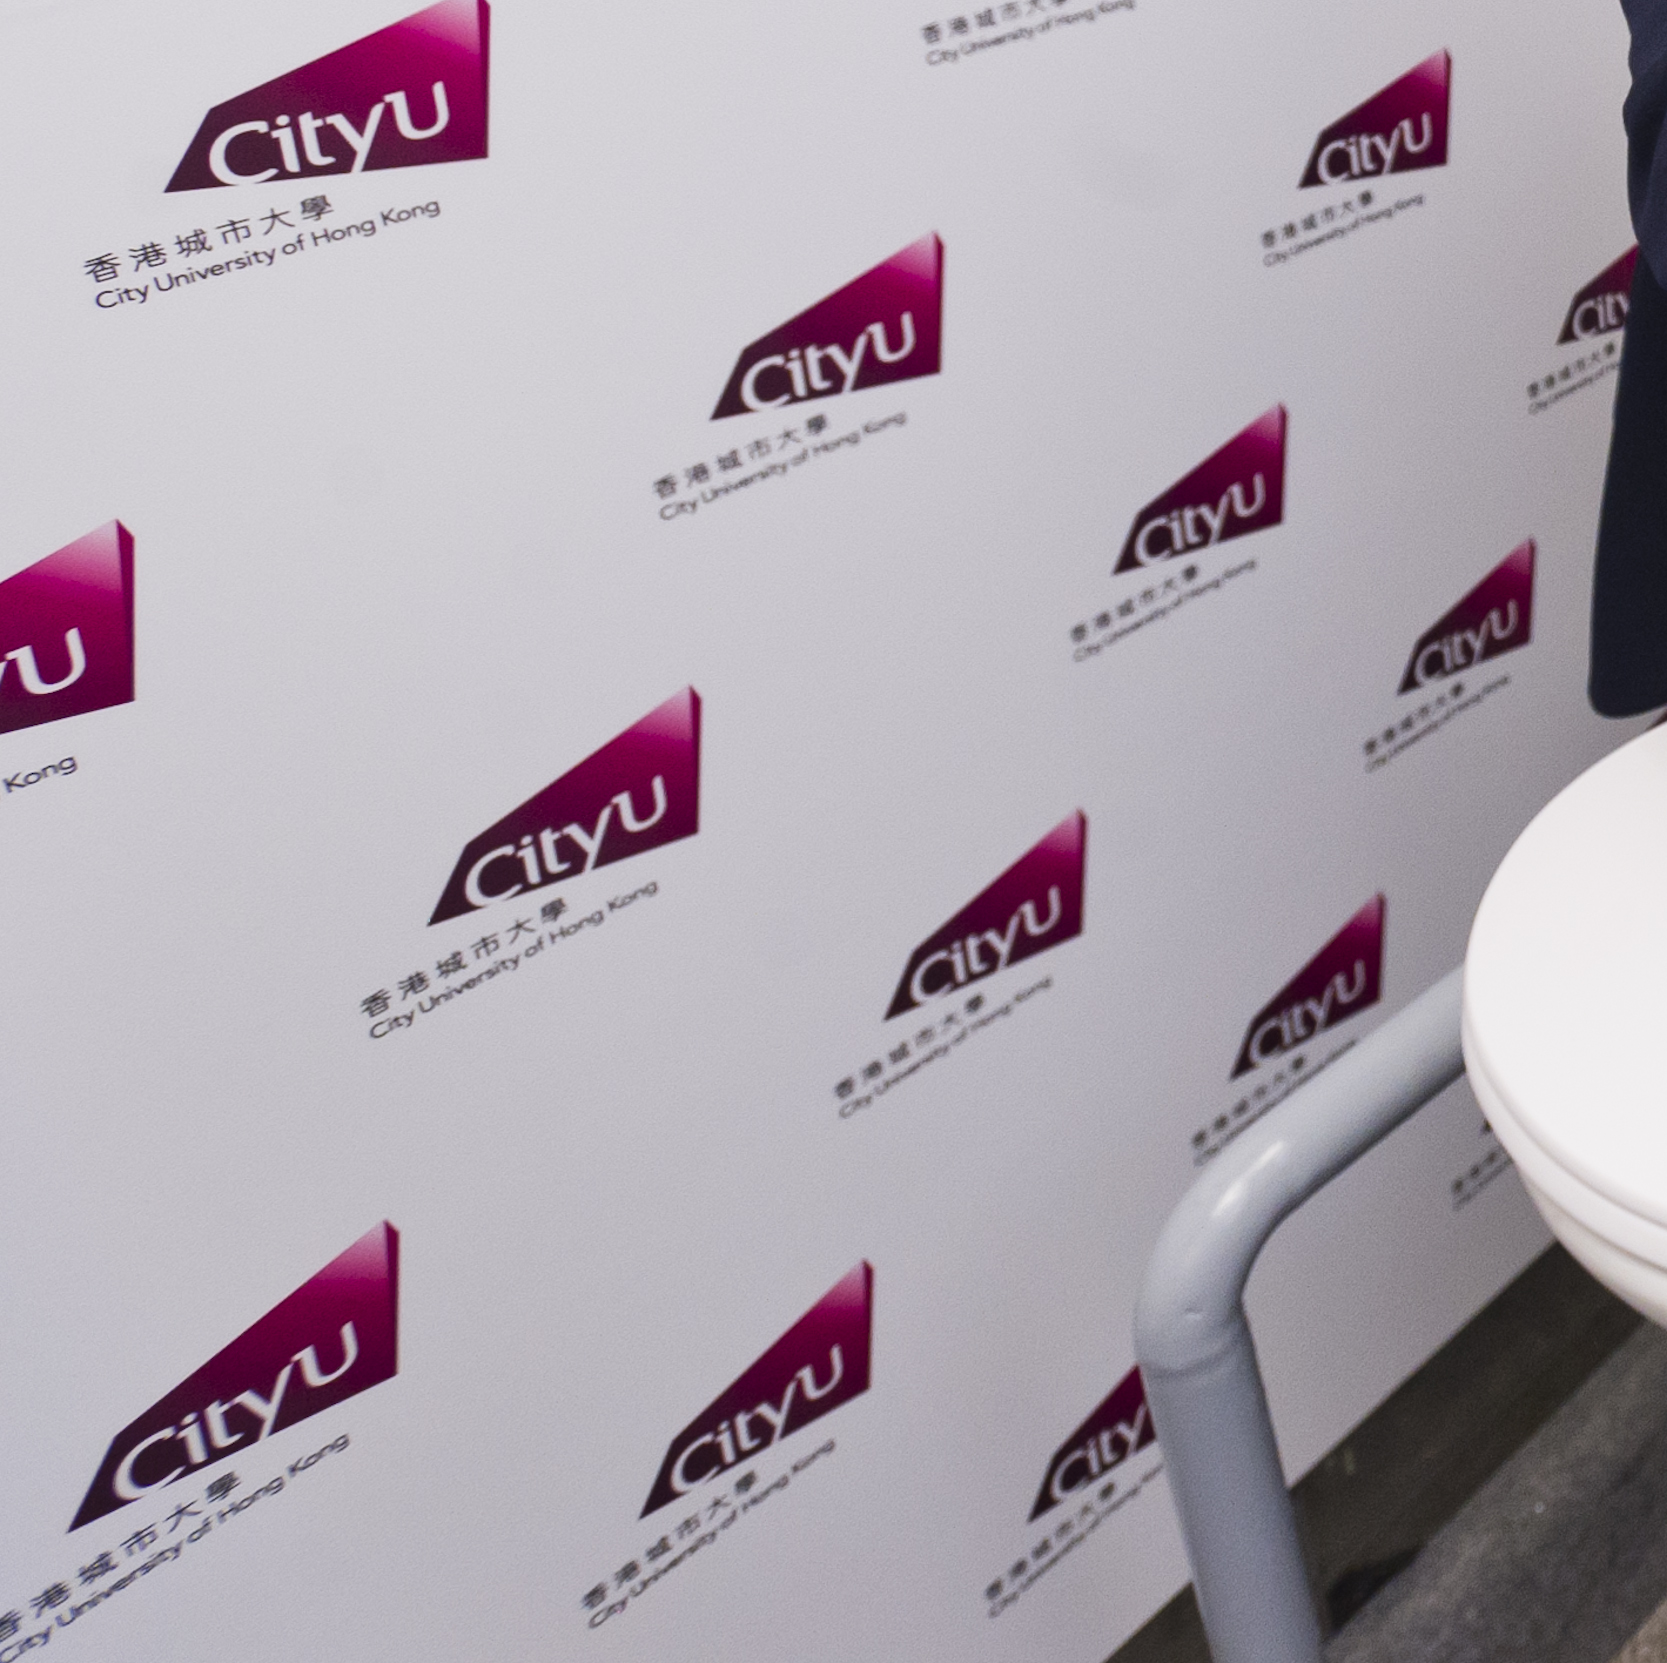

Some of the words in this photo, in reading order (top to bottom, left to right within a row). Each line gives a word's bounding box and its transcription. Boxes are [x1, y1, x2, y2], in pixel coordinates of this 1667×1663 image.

[208, 79, 451, 187] CityU
[1318, 110, 1431, 185] CityU
[85, 193, 335, 284] 香港城市大學
[95, 284, 150, 309] City
[153, 247, 276, 293] University
[281, 232, 305, 256] of
[310, 219, 378, 247] Hong
[380, 200, 443, 227] Kong
[740, 310, 915, 412] CityU
[1135, 471, 1265, 566] CityU
[1416, 599, 1516, 685] CityU
[3, 756, 78, 794] Kong
[463, 772, 668, 909] CityU
[361, 896, 569, 1018] 香港城市大學
[370, 1009, 415, 1039] City
[418, 953, 520, 1014] University
[524, 934, 544, 958] of
[548, 909, 605, 945] Hong
[607, 880, 659, 914] Kong
[909, 883, 1061, 1005] CityU
[1250, 959, 1364, 1065] CityU
[113, 1315, 363, 1500] CityU
[669, 1342, 843, 1494] CityU
[0, 1623, 54, 1663] City
[58, 1540, 183, 1626] University
[188, 1515, 212, 1543] of
[217, 1475, 286, 1524] Hong
[289, 1432, 353, 1477] Kong
